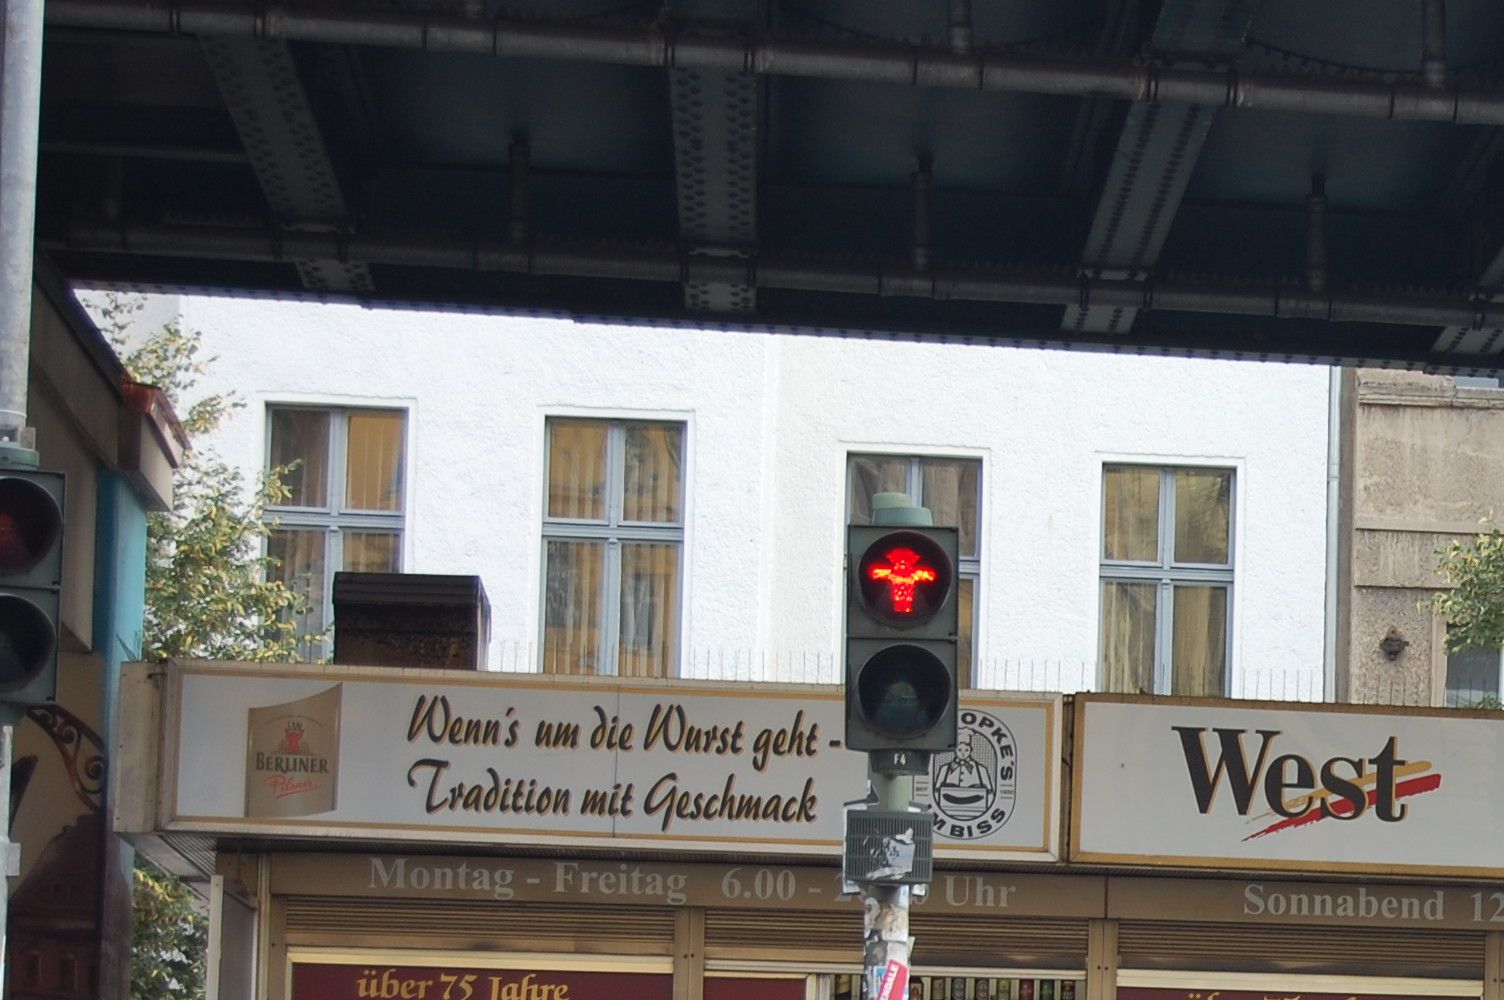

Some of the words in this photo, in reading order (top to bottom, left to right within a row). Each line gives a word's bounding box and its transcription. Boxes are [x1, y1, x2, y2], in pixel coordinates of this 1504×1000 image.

[534, 719, 580, 749] um
[590, 705, 634, 751] die
[643, 702, 744, 755] Wurst
[753, 709, 819, 771] geht
[255, 752, 329, 775] BERLINER
[893, 753, 907, 766] F4
[1171, 725, 1409, 824] West
[407, 758, 571, 816] Tradition
[580, 782, 634, 817] mit
[642, 772, 819, 831] Geschmack
[933, 807, 1007, 838] MBISS
[366, 856, 515, 899] Montag
[551, 860, 688, 904] Freitag
[720, 868, 796, 901] 6.00
[945, 876, 1017, 907] Uhr
[1242, 884, 1445, 923] Sonnabend
[357, 969, 433, 1000] über
